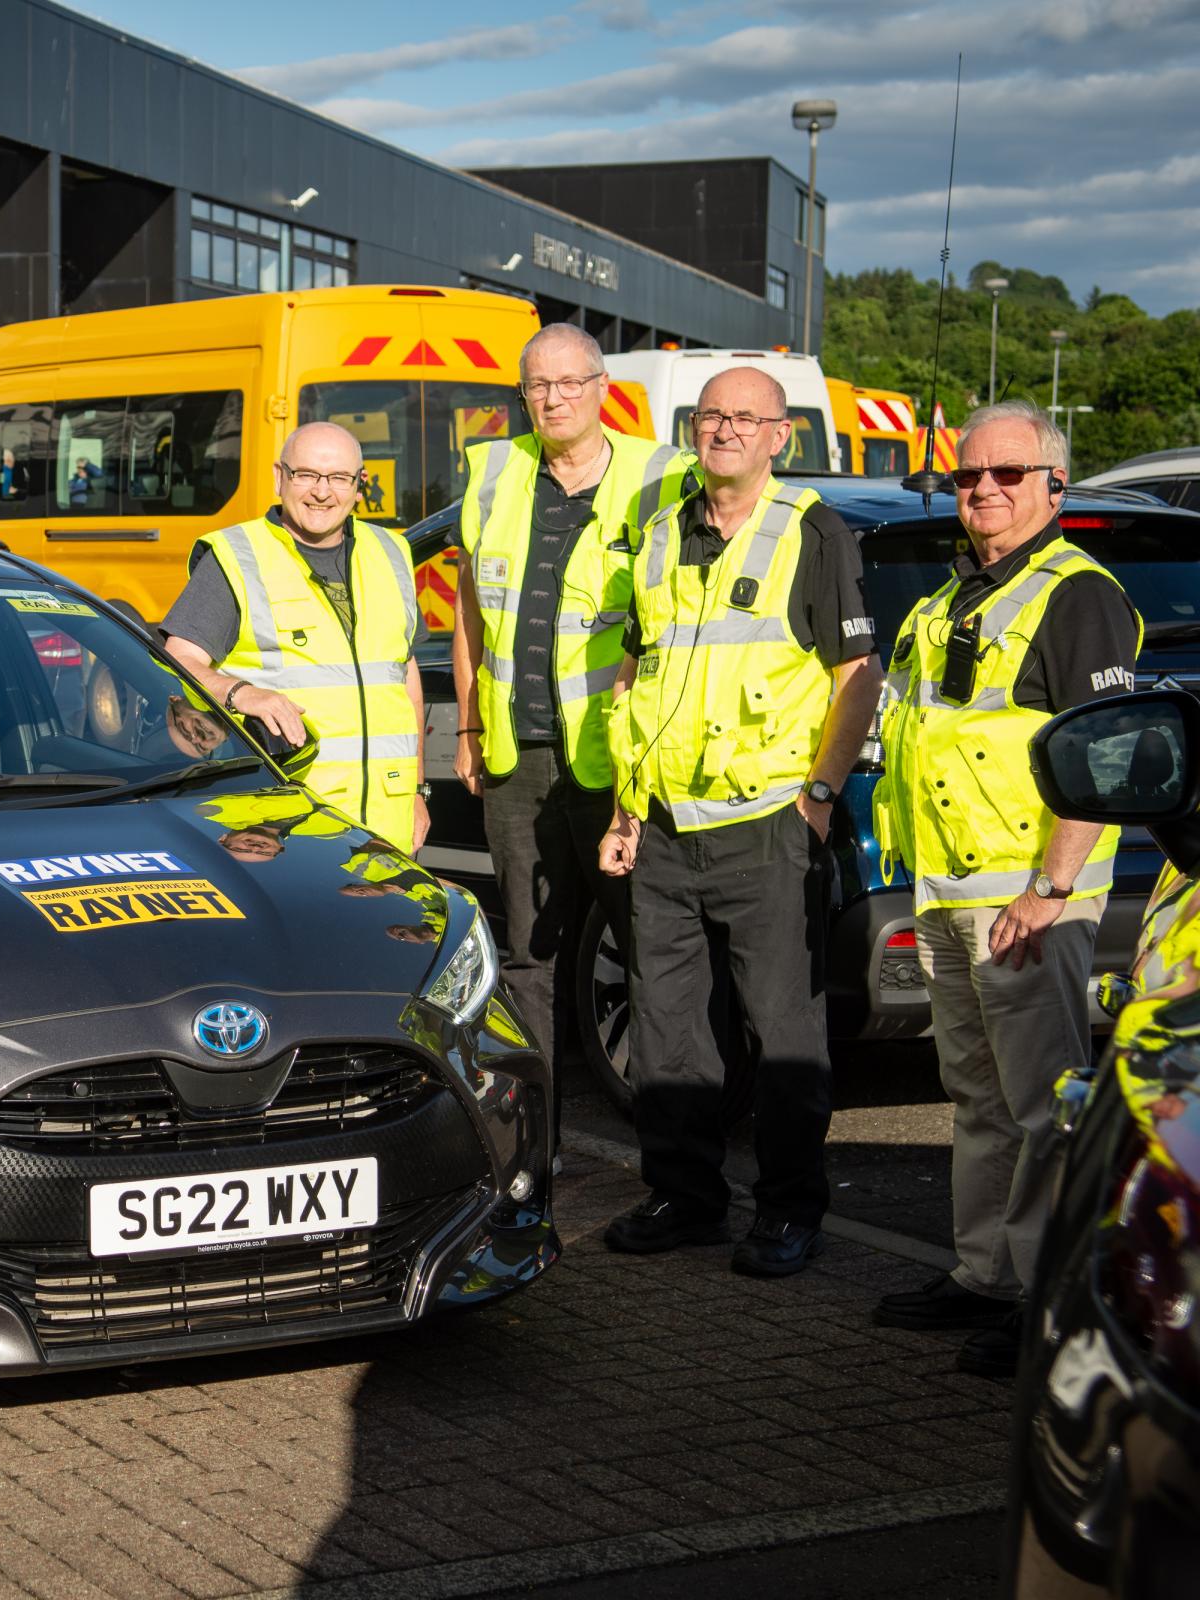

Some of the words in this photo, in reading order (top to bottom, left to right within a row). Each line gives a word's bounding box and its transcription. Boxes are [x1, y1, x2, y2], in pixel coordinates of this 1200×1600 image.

[1090, 665, 1135, 692] RAYET
[30, 884, 135, 902] COMMUNICATIONS
[135, 880, 191, 893] PROVIDED
[192, 881, 208, 890] BY
[39, 890, 231, 928] RAYNET
[118, 1179, 250, 1241] SG22
[266, 1167, 360, 1227] WXY
[197, 1238, 268, 1254] helensburgh.toyota.co.uk
[311, 1232, 335, 1241] TOYOTA
